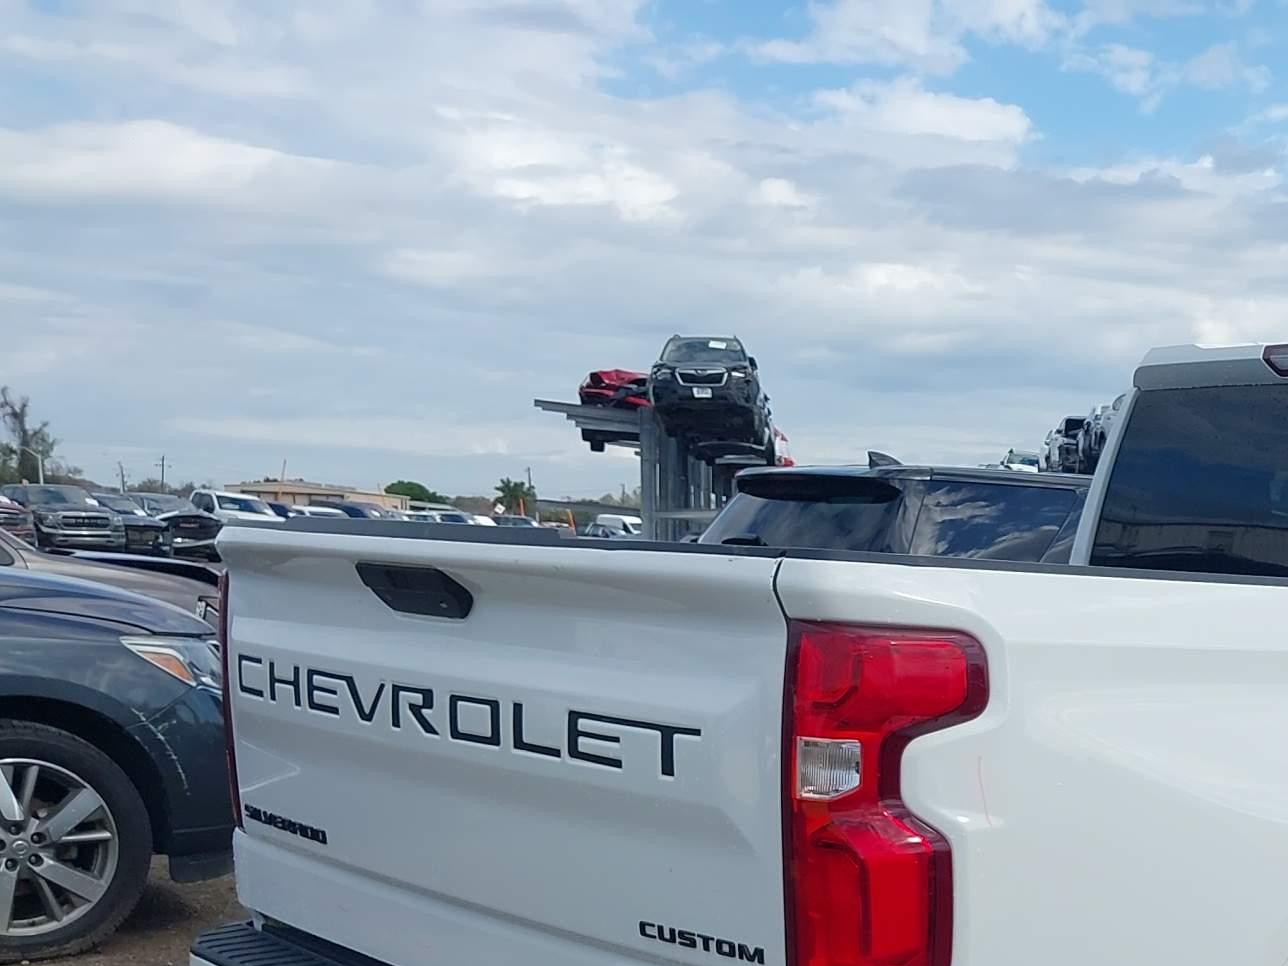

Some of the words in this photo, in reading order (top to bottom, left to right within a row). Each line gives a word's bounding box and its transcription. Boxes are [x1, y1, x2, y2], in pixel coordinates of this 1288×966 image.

[238, 653, 702, 777] CHEVROLET
[244, 803, 328, 845] SILVERADO
[639, 920, 765, 965] CUSTOM
